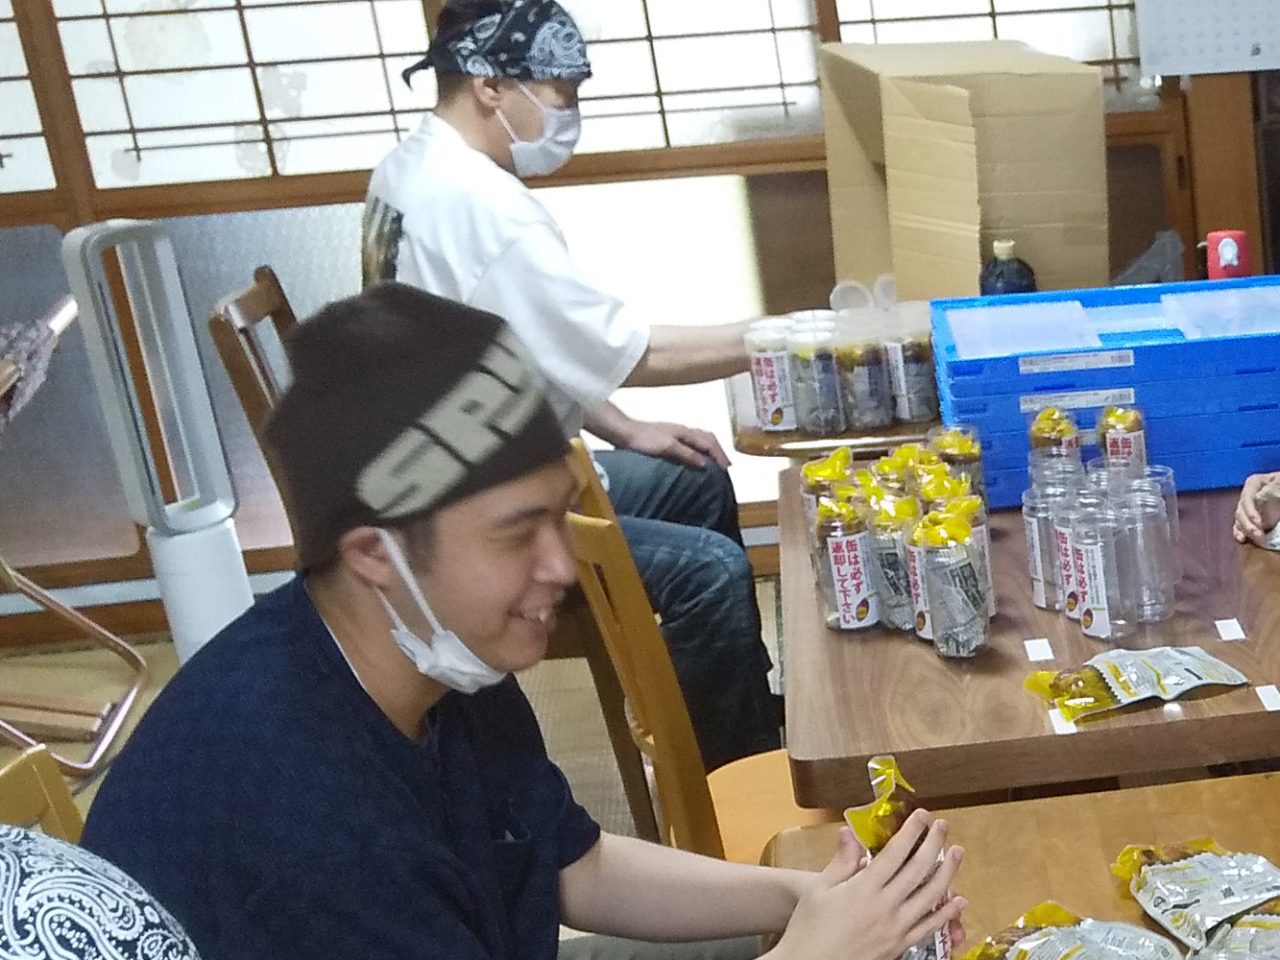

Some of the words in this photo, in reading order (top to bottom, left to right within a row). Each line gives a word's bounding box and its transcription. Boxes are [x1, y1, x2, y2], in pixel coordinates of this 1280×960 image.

[831, 541, 856, 624] 返却して下さい
[845, 539, 865, 595] 缶は必ず
